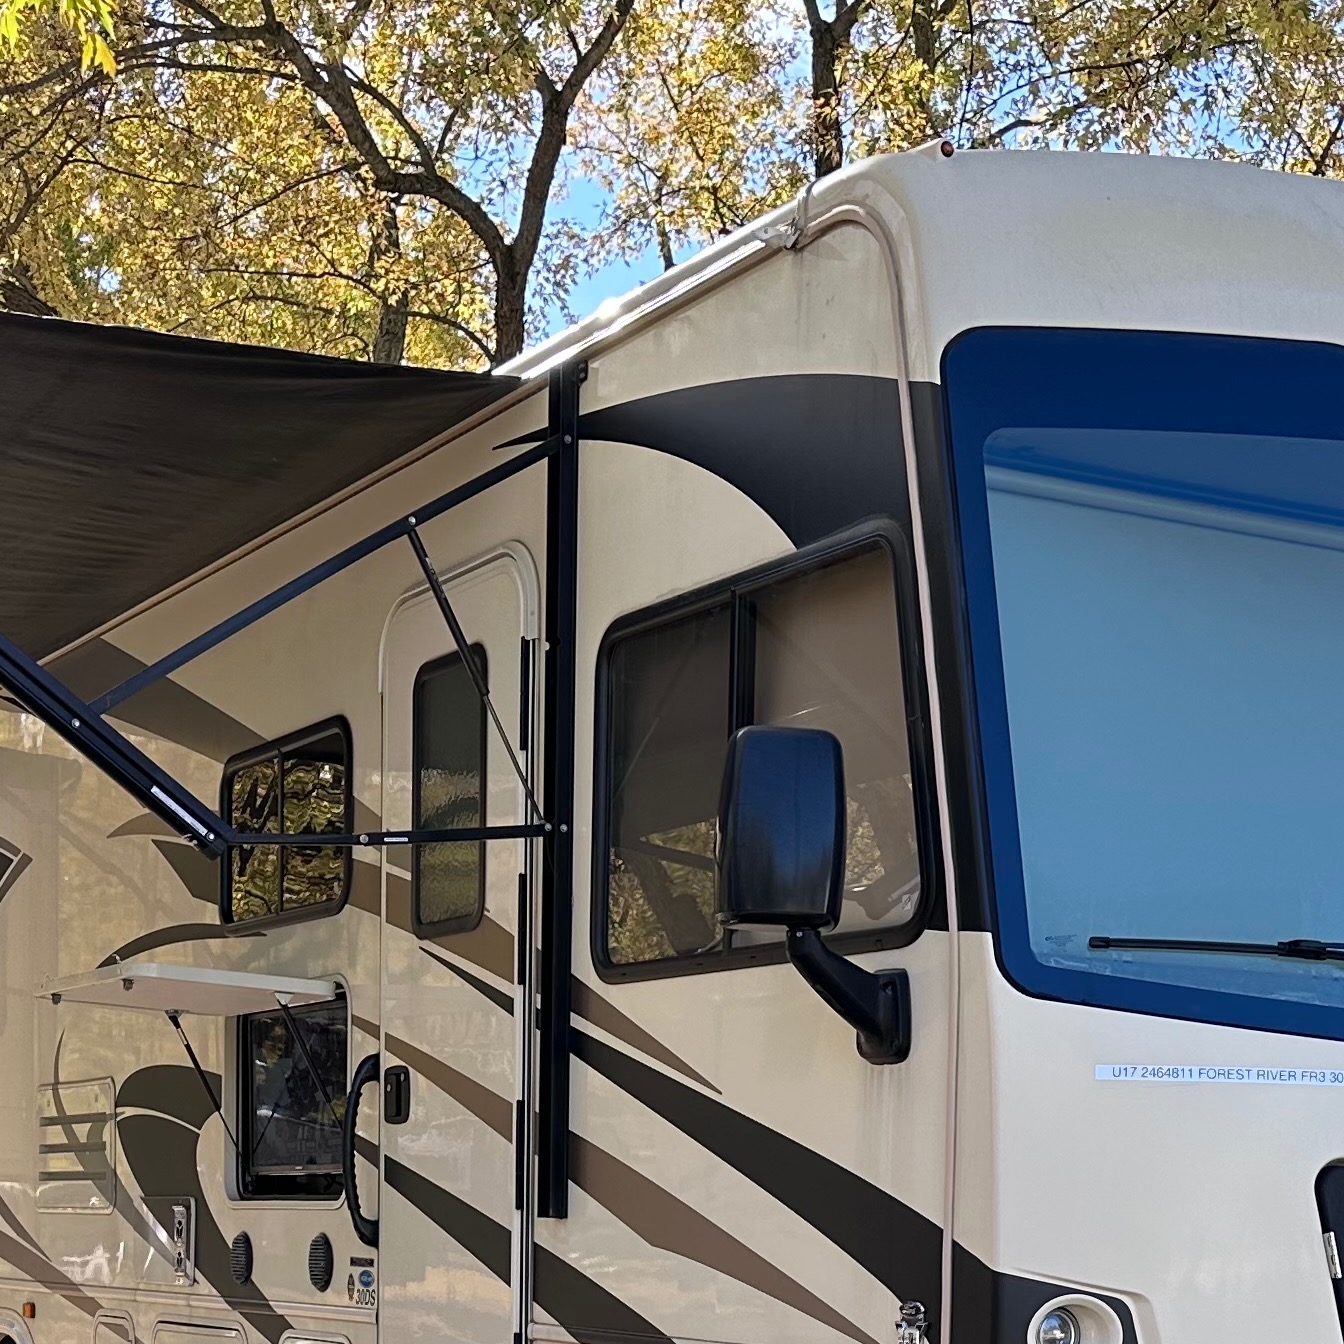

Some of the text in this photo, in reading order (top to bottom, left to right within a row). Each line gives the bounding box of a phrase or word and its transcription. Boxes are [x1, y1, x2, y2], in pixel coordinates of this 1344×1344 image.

[1112, 1066, 1137, 1078] U17
[1141, 1066, 1193, 1079] 2464811
[1198, 1068, 1254, 1081] FOREST
[1256, 1070, 1297, 1082] RIVER
[1301, 1071, 1326, 1083] FR3
